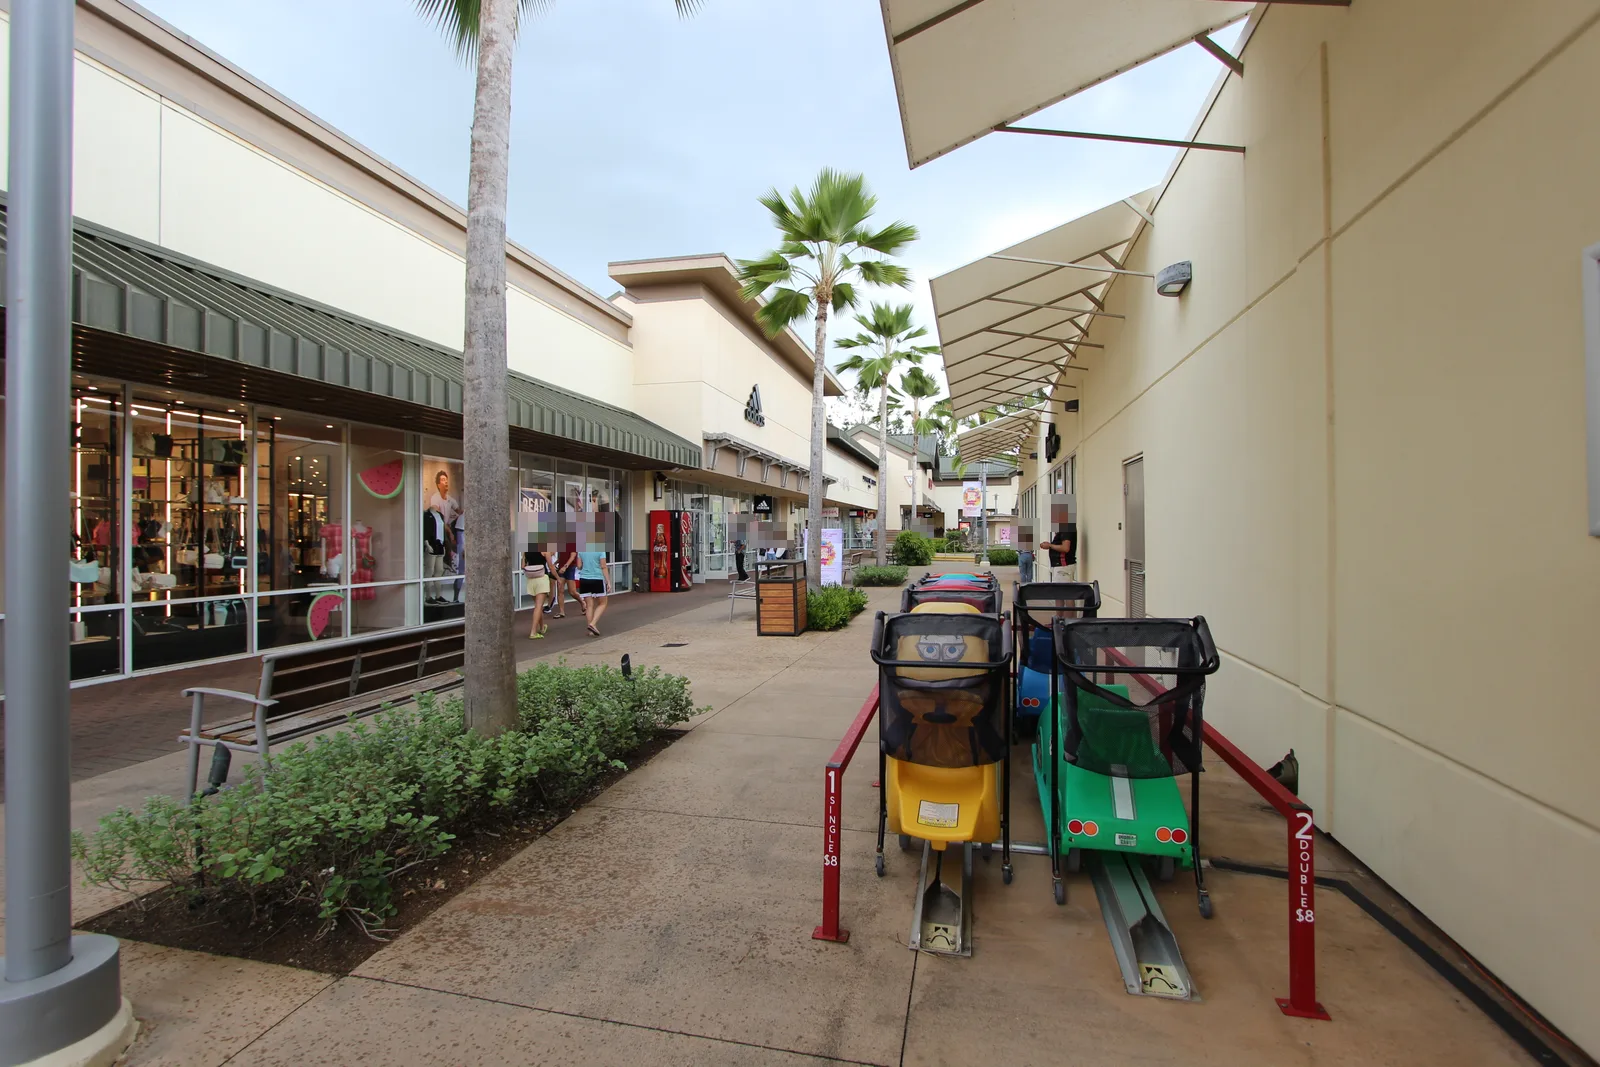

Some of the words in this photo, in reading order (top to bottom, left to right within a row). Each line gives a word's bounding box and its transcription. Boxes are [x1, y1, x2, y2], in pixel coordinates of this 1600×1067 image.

[744, 407, 765, 427] adidas
[522, 498, 549, 512] READY
[828, 770, 836, 794] 1
[828, 796, 836, 853] SINGLE
[1295, 812, 1313, 840] 2
[824, 854, 838, 867] $8
[1300, 840, 1310, 908] DOUBLE
[1296, 908, 1315, 922] $8
